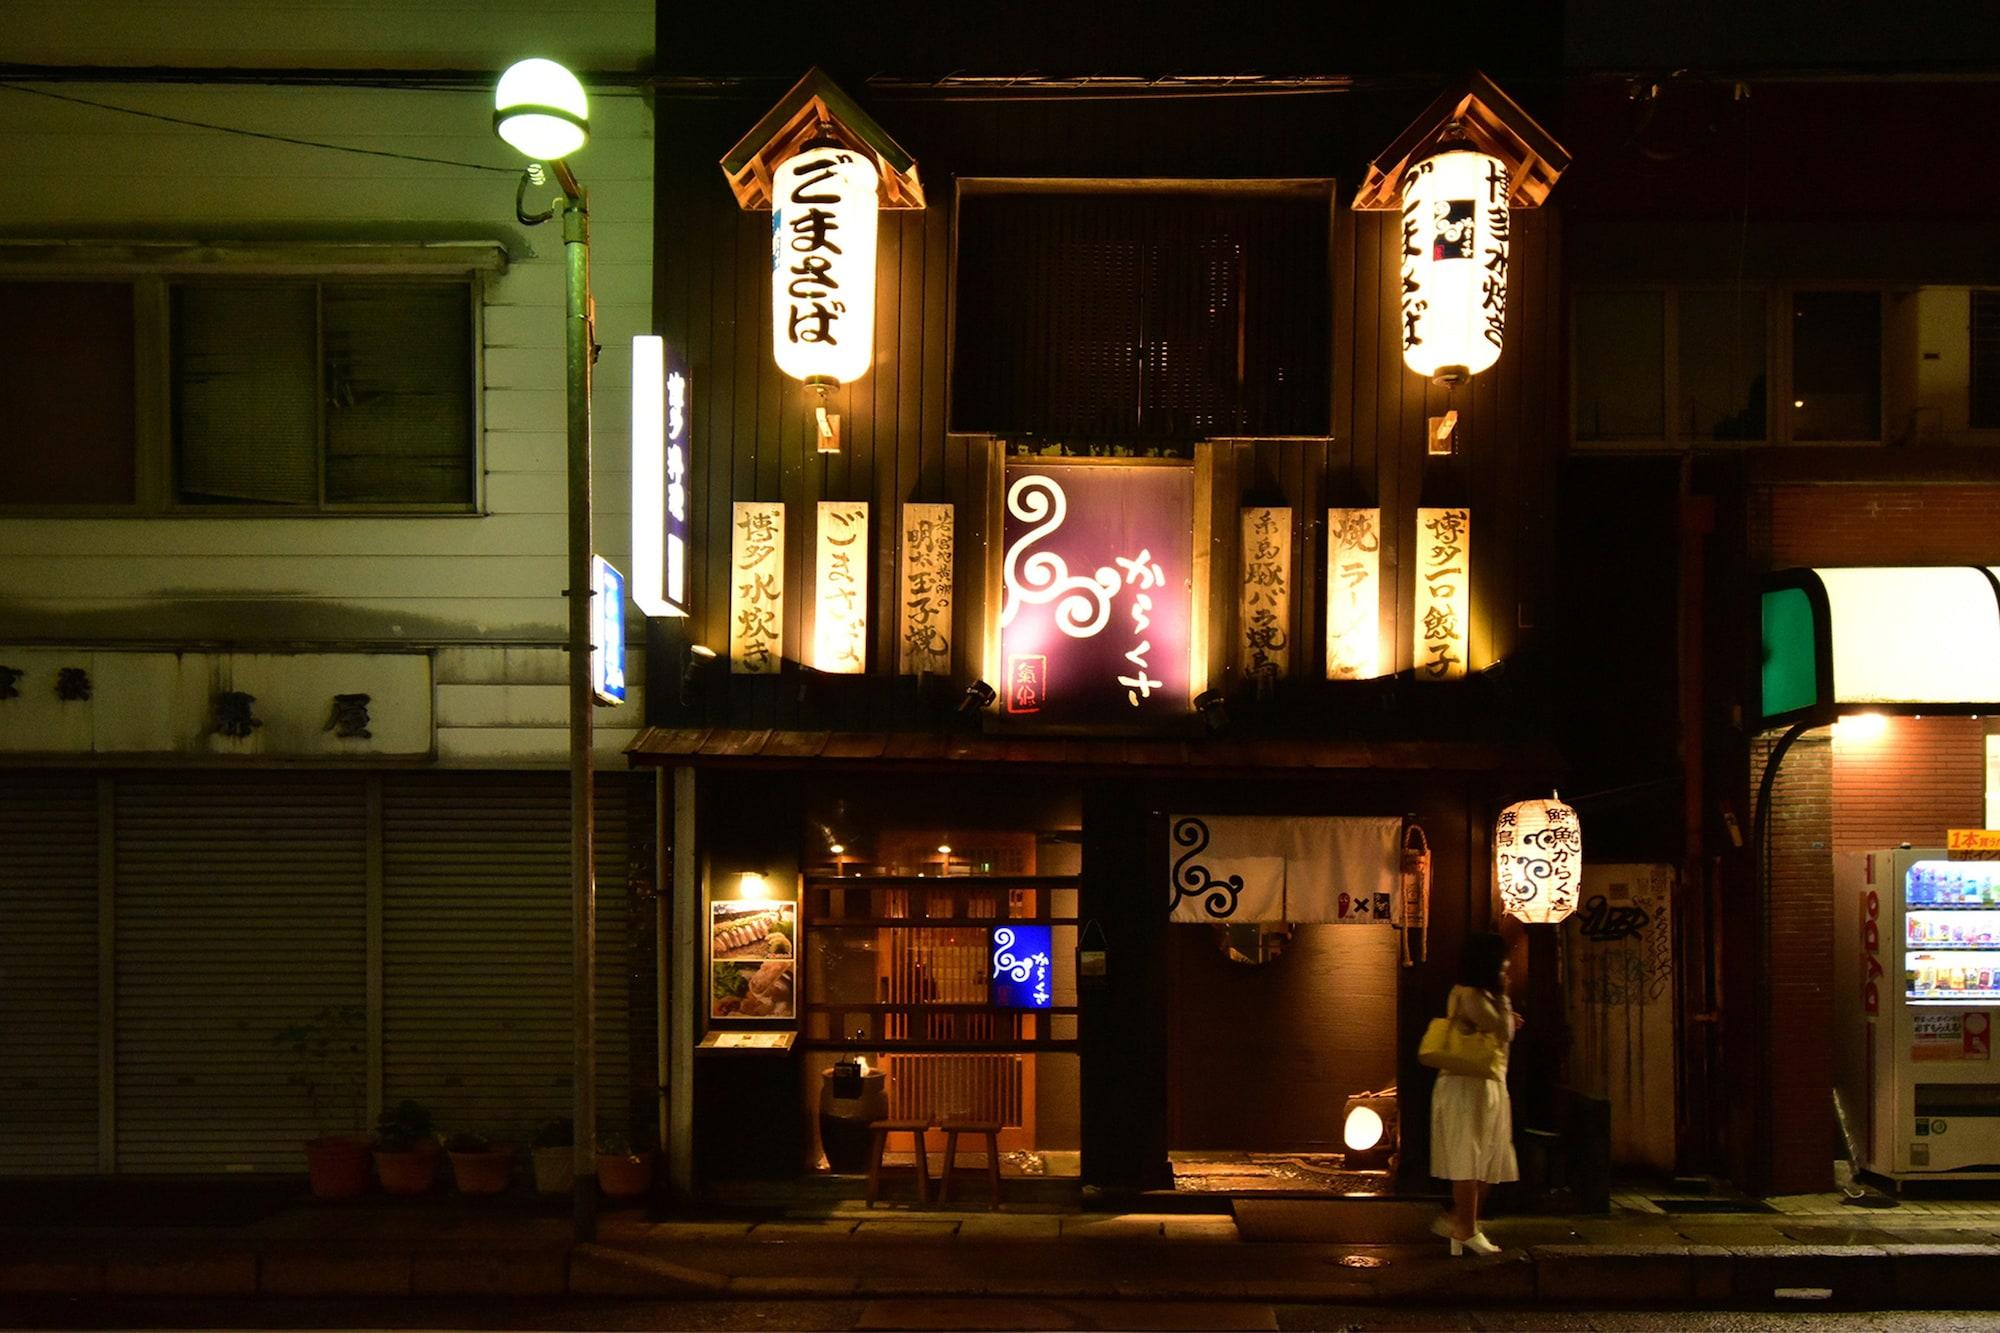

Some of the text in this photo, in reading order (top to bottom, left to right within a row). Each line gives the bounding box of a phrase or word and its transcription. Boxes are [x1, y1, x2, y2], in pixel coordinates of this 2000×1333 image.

[737, 510, 781, 671] 博多水炊き
[1115, 549, 1166, 707] からくさ
[1331, 513, 1378, 674] 焼ラー
[1031, 952, 1049, 1005] からくさ
